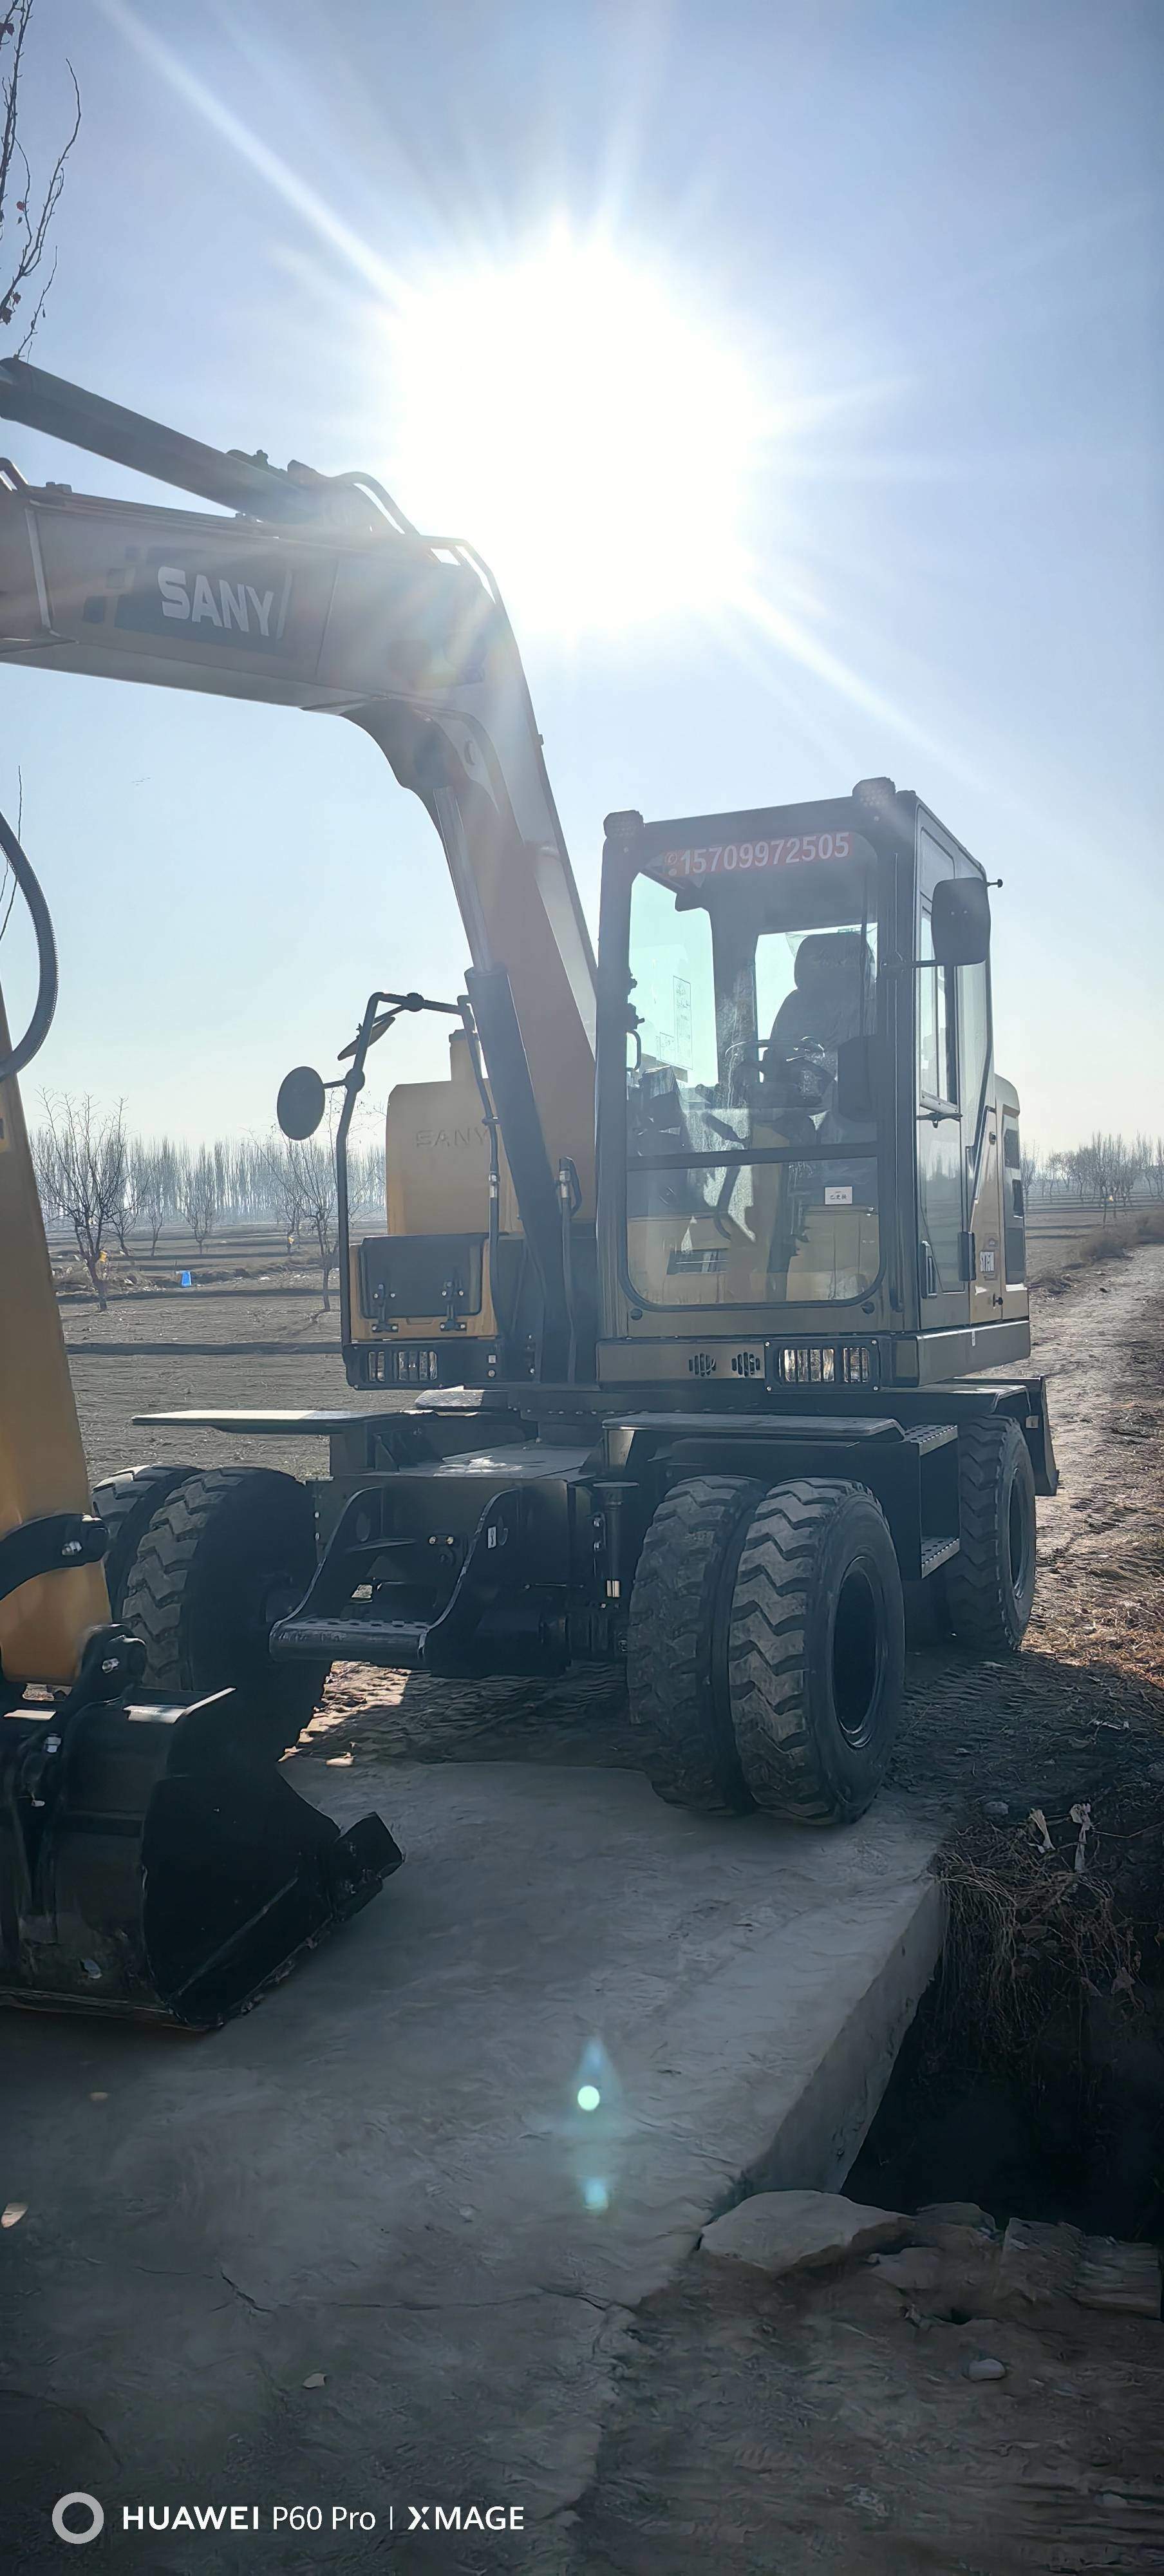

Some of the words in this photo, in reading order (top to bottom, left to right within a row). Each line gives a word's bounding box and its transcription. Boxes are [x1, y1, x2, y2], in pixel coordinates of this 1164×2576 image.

[158, 566, 274, 637] SANY
[681, 832, 850, 875] 15709972505
[416, 1127, 487, 1147] SANY
